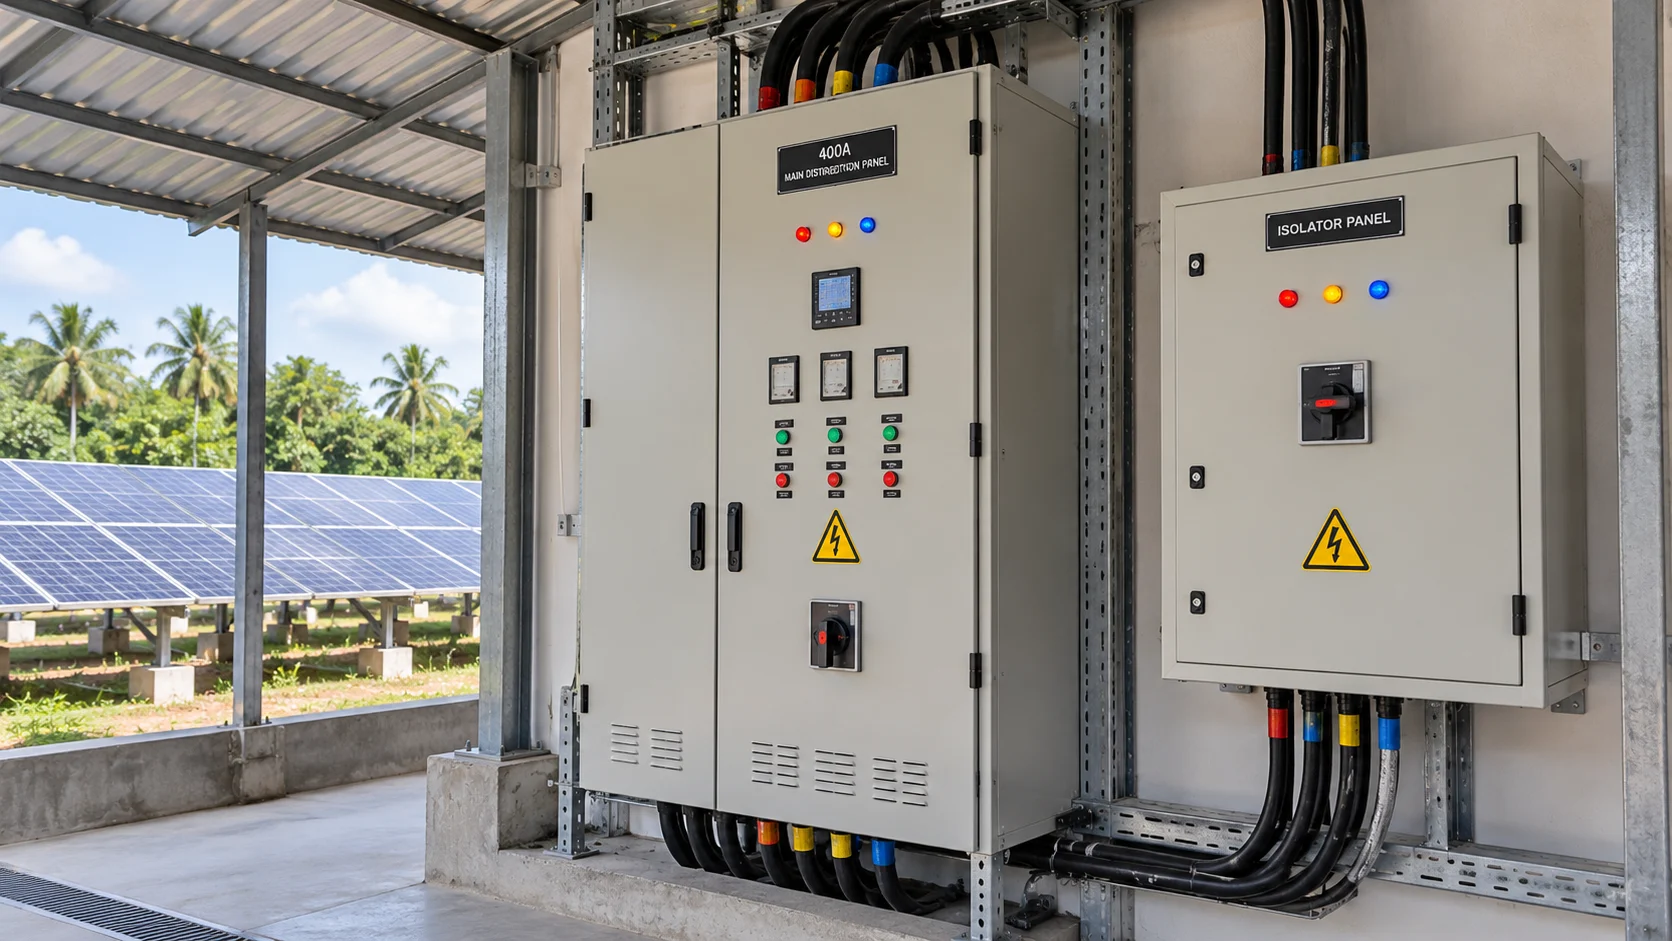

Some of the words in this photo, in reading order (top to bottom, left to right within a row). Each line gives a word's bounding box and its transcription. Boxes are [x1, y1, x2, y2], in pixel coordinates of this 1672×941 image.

[819, 142, 851, 160] 400A
[784, 170, 804, 182] MAIN
[862, 156, 889, 169] PANEL
[1278, 217, 1342, 236] ISOLATOR
[1346, 212, 1391, 228] PANEL
